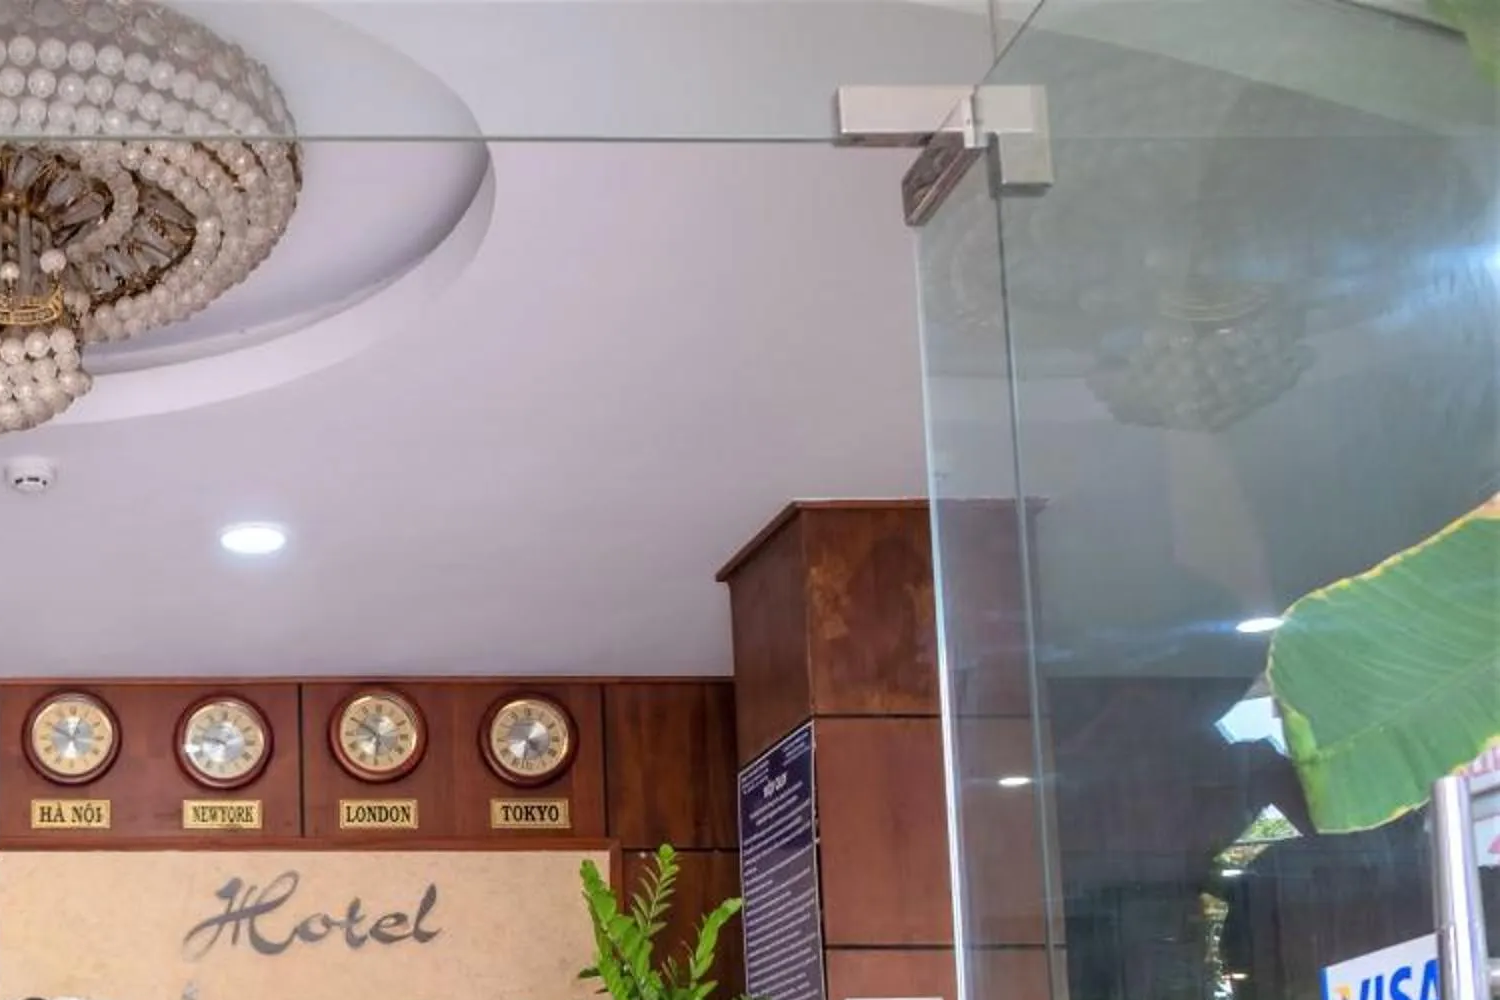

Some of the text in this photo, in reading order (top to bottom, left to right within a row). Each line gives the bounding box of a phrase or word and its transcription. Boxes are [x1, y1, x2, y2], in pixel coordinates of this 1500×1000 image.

[191, 805, 255, 824] NEWYORK
[346, 805, 411, 824] LONDON
[501, 805, 560, 822] TOKYO
[183, 869, 442, 962] Hotel
